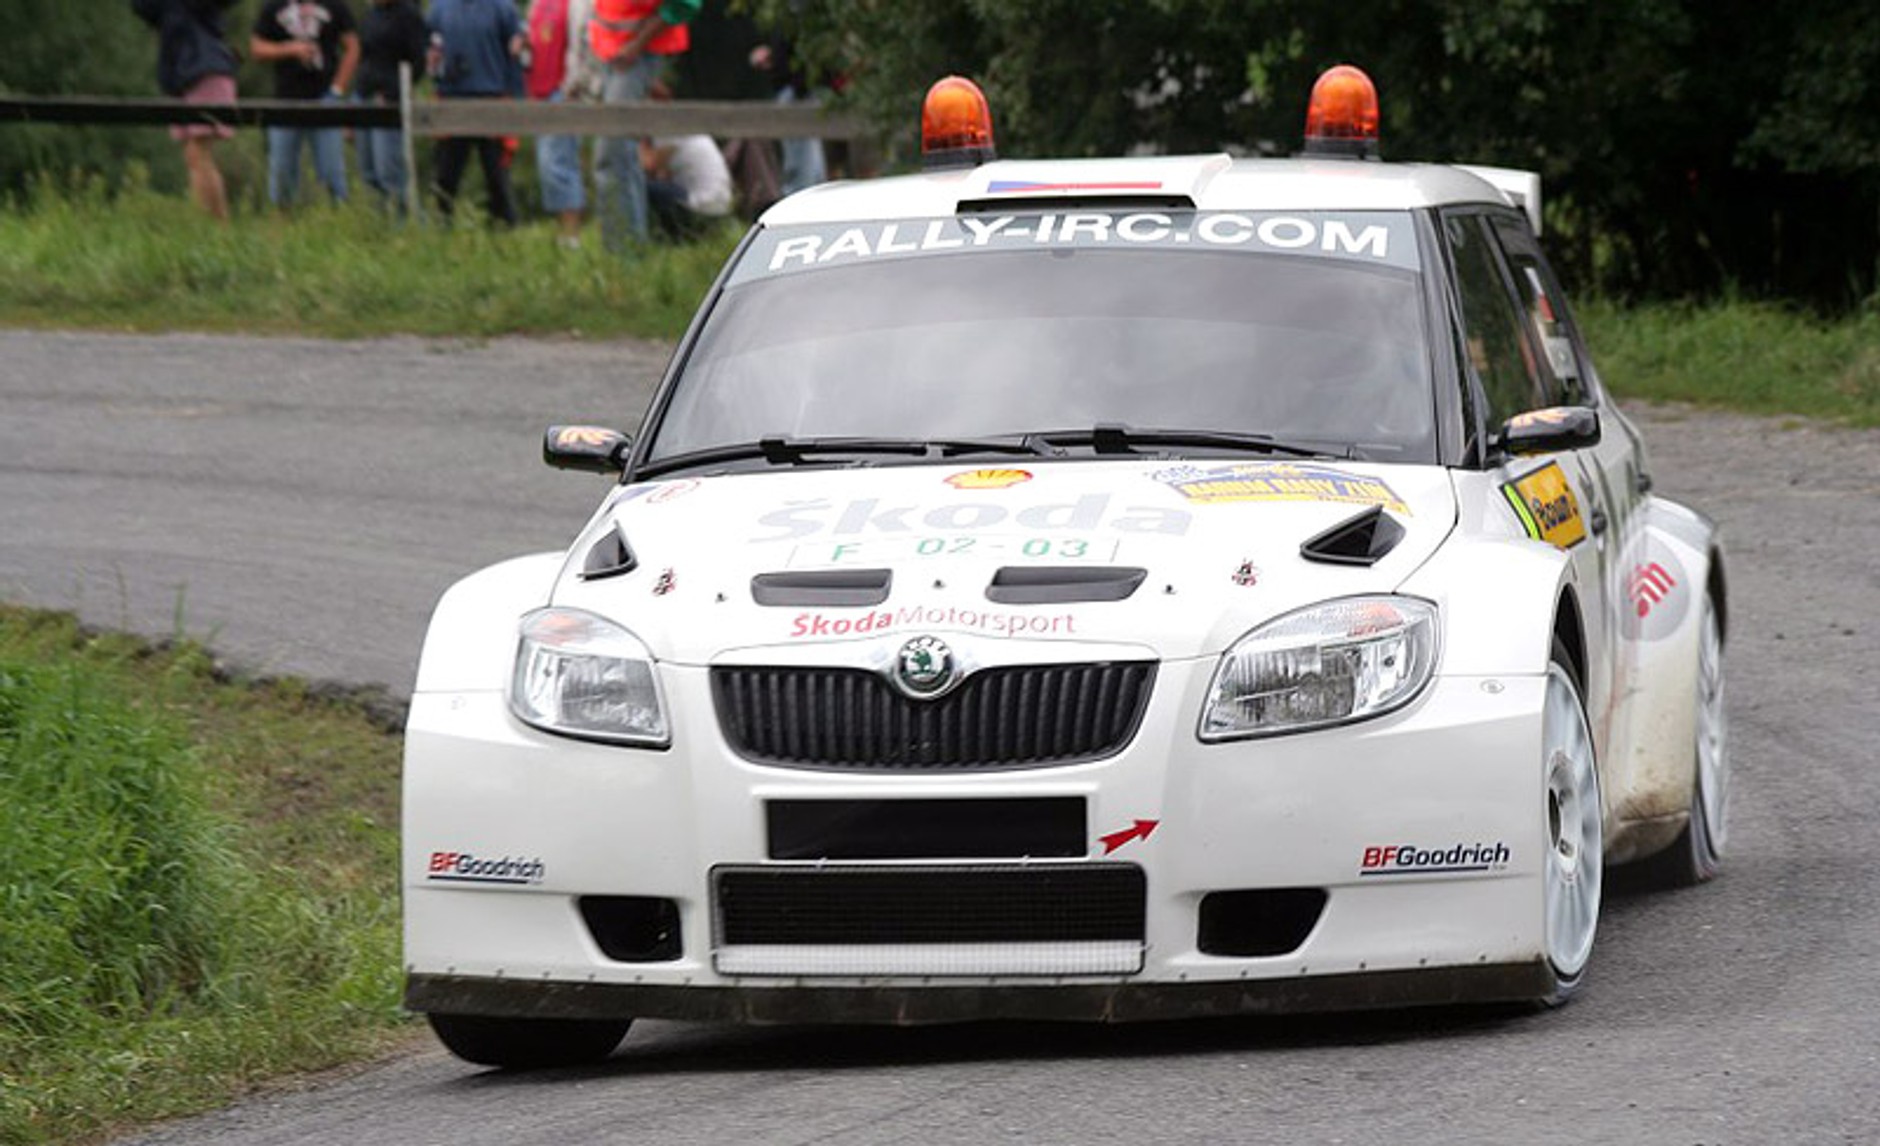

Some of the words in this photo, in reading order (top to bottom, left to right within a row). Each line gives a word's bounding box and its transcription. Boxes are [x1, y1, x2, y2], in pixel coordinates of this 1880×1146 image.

[769, 213, 1390, 271] RALLY-IRC.COM
[831, 543, 864, 563] F
[428, 852, 545, 877] BFGoodrich
[1362, 842, 1510, 867] BFGoodrich
